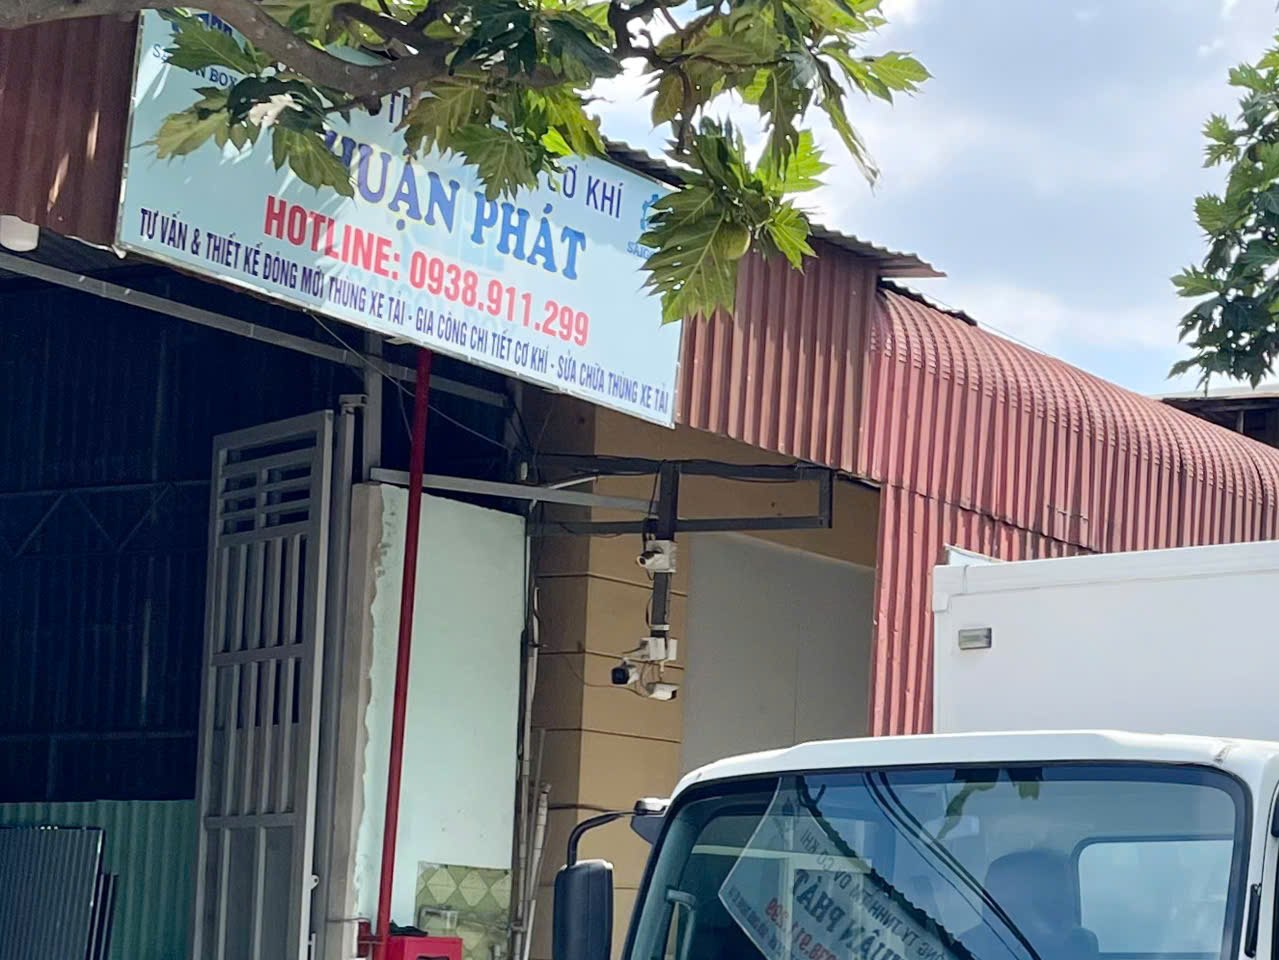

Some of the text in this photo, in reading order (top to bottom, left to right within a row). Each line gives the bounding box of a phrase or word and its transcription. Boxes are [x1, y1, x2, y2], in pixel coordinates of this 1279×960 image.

[471, 191, 586, 280] PHÁT
[586, 175, 623, 219] KHÍ
[140, 207, 159, 240] TƯ
[160, 211, 188, 251] VẤN
[191, 228, 201, 257] &
[205, 232, 241, 270] THIẾT
[243, 241, 263, 277] KẾ
[262, 251, 298, 289] ĐÓNG
[300, 264, 325, 299] MỚI
[328, 272, 367, 313] THÙNG
[369, 290, 385, 319] XE
[387, 291, 406, 326] TẢI
[415, 306, 434, 337] GIA
[437, 311, 467, 346] CÔNG
[470, 325, 488, 354] CHI
[491, 328, 513, 361] TIẾT
[514, 340, 530, 368] CƠ
[530, 345, 550, 374] KHÍ
[557, 350, 577, 383] SỬA
[579, 361, 605, 393] CHỮA
[608, 371, 638, 405] THÙNG
[640, 383, 653, 409] XE
[654, 382, 669, 415] TẢI
[264, 195, 590, 347] HOTLINE: 0938.911.299
